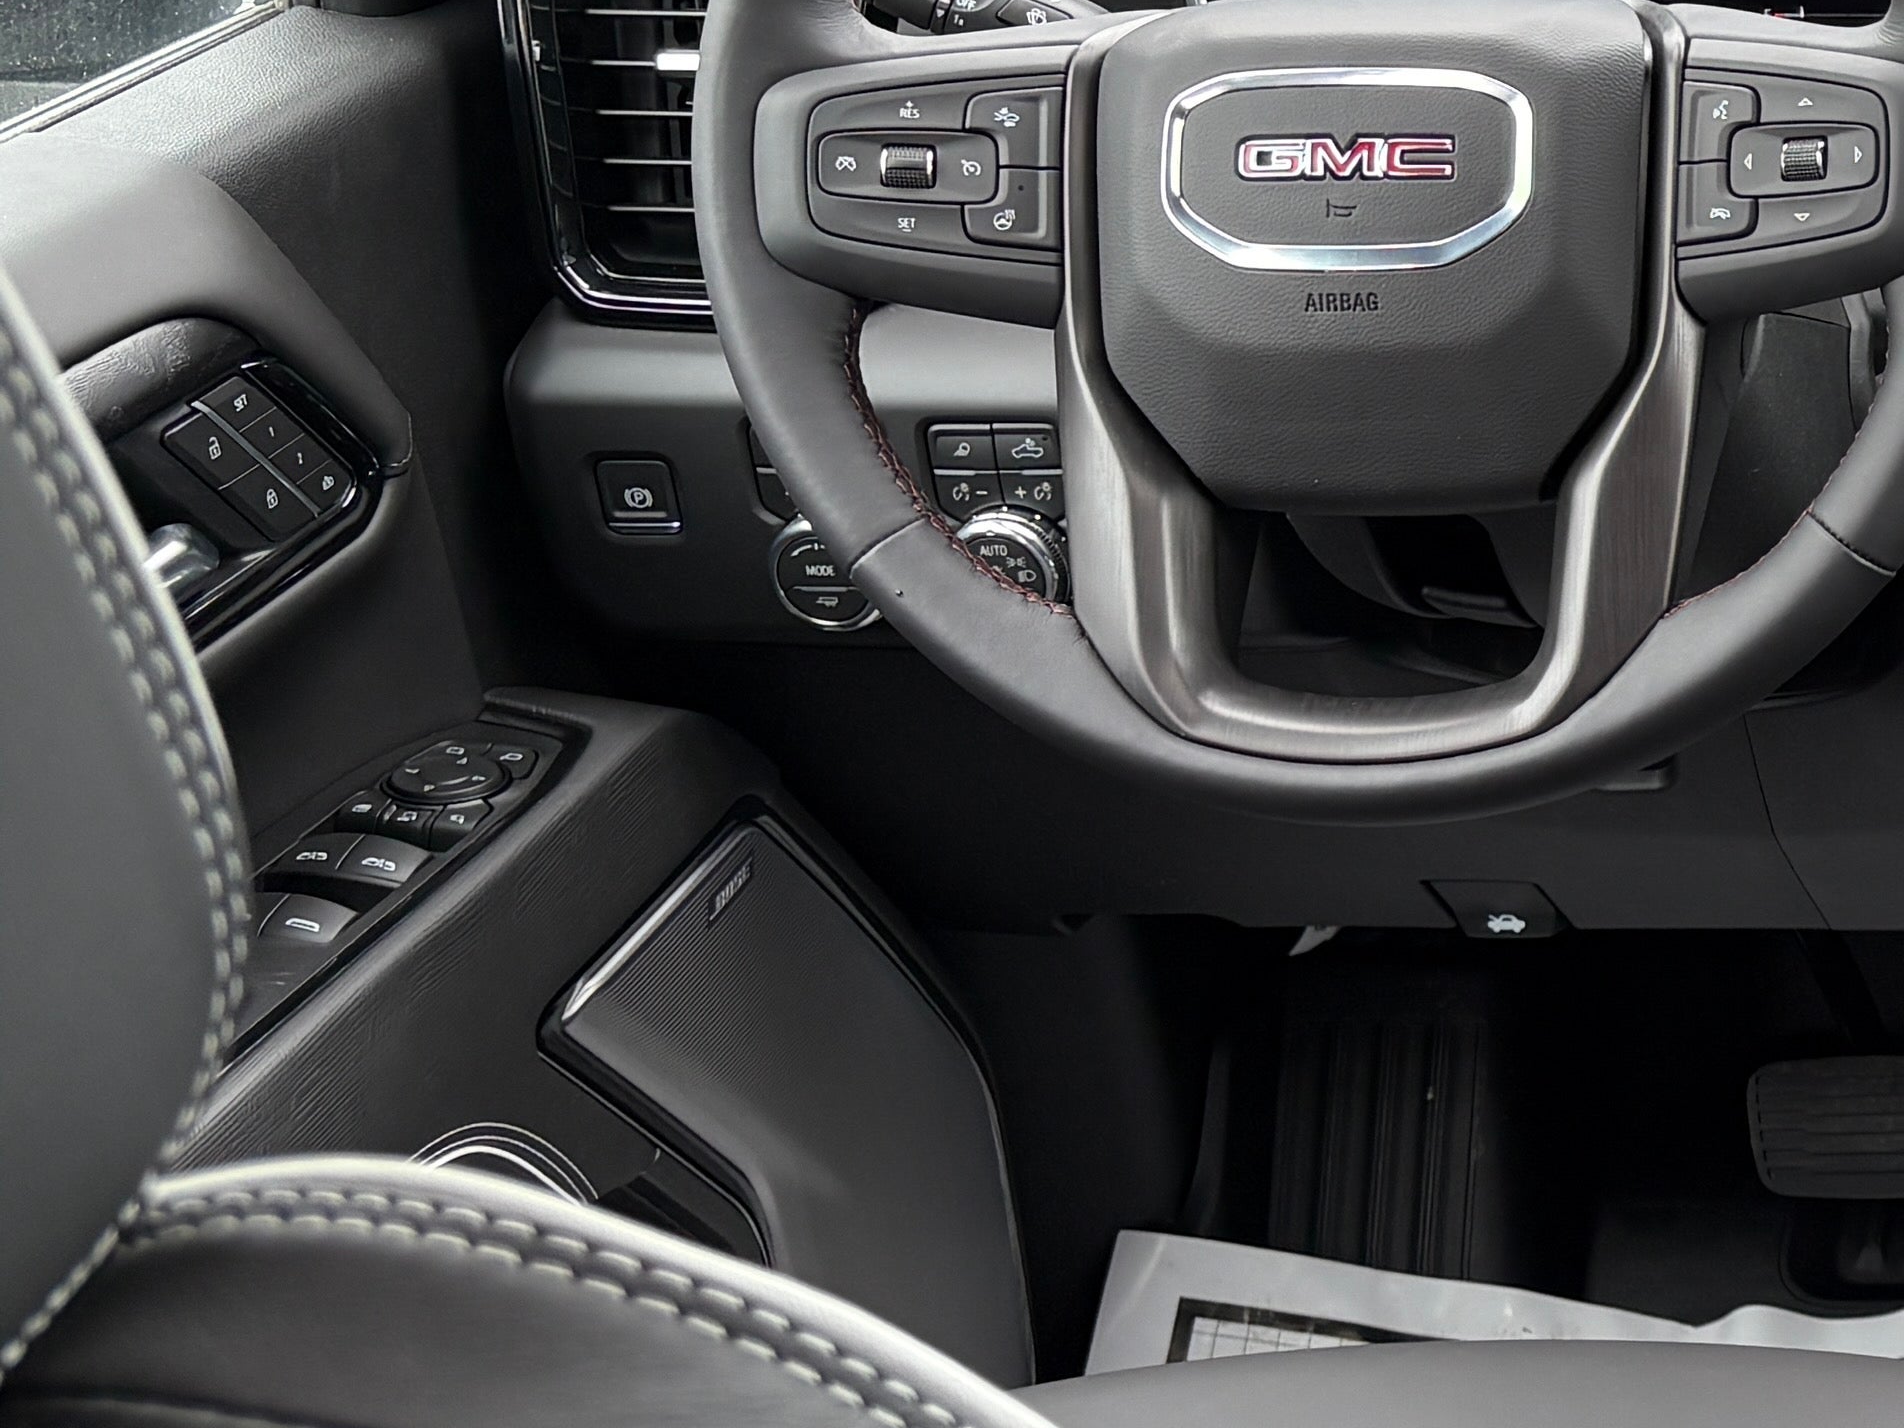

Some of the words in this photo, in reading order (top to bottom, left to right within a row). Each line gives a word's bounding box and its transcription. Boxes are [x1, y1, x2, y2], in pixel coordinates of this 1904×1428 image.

[899, 108, 920, 119] RES
[1238, 136, 1456, 178] GMC
[898, 217, 916, 229] SET
[1304, 292, 1379, 313] AIRBAG
[979, 544, 1008, 557] AUTO
[805, 564, 835, 577] MODE
